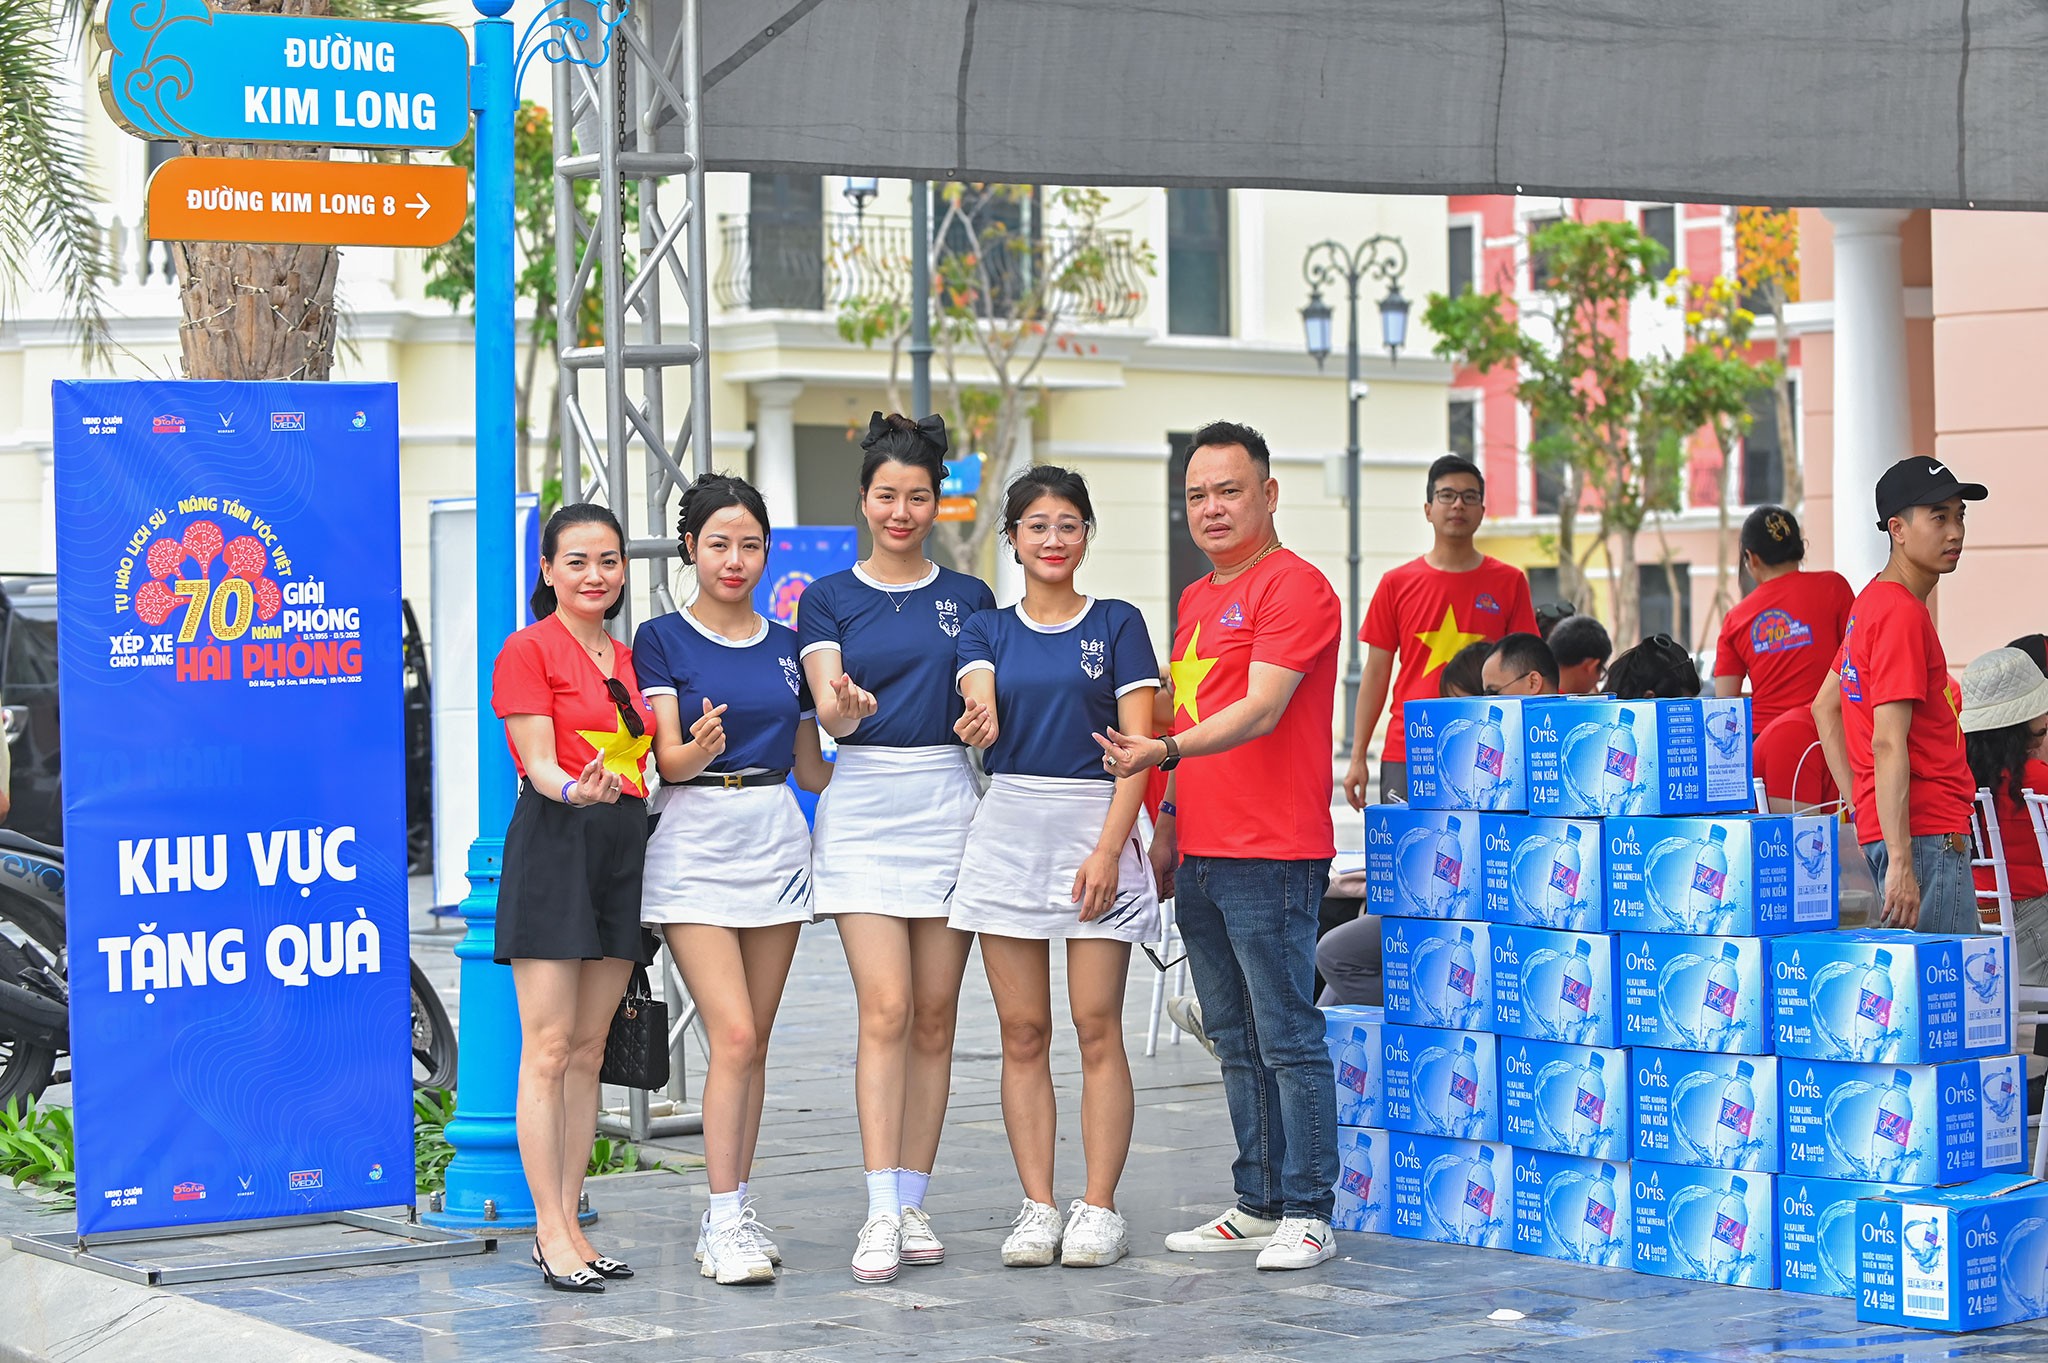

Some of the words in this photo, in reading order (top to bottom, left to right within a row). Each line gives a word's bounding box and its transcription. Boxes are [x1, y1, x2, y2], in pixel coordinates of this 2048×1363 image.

[284, 34, 395, 74] ĐƯỜNG
[244, 86, 320, 127] KIM
[335, 89, 436, 131] LONG
[187, 187, 264, 212] ĐƯỜNG
[272, 192, 314, 214] KIM
[320, 192, 376, 215] LONG
[383, 195, 396, 216] 8
[178, 495, 218, 515] NÂNG
[148, 507, 168, 530] SỬ
[126, 524, 153, 557] LỊCH
[251, 516, 279, 547] VÓC
[271, 545, 292, 577] VIỆT
[114, 557, 134, 590] HÀO
[283, 575, 325, 605] GIẢI
[114, 593, 132, 614] TỰ
[175, 578, 254, 643] 70
[252, 623, 282, 640] NĂM
[283, 605, 360, 633] PHÓNG
[109, 628, 144, 655] XẾP
[150, 634, 174, 653] XE
[109, 654, 139, 668] CHÀO
[141, 651, 174, 667] MỪNG
[176, 635, 231, 682] HẢI
[242, 635, 362, 679] PHÒNG
[1668, 766, 1680, 777] ION
[1413, 780, 1424, 797] 24
[1533, 786, 1546, 803] 24
[1669, 783, 1683, 800] 24
[118, 834, 228, 896] KHU
[247, 825, 357, 898] VỰC
[1372, 886, 1382, 902] 24
[1613, 882, 1628, 890] WATER
[1487, 893, 1497, 910] 24
[1613, 899, 1627, 917] 24
[1761, 904, 1773, 921] 24
[98, 922, 246, 1004] TẶNG
[265, 907, 381, 988] QUÀ
[1389, 993, 1399, 1010] 24
[1497, 1005, 1508, 1022] 24
[1627, 1014, 1640, 1032] 24
[1780, 1024, 1793, 1043] 24
[1929, 1030, 1942, 1049] 24
[1388, 1101, 1399, 1118] 24
[1508, 1115, 1519, 1132] 24
[1640, 1130, 1654, 1148] 24
[1791, 1142, 1805, 1160] 24
[1947, 1150, 1960, 1169] 24
[291, 1179, 321, 1187] MEDIA
[1397, 1208, 1408, 1225] 24
[1517, 1224, 1529, 1241] 24
[1637, 1242, 1650, 1260] 24
[1786, 1259, 1799, 1278] 24
[1862, 1271, 1875, 1284] ION
[1863, 1289, 1879, 1308] 24
[1879, 1291, 1895, 1303] chai
[1968, 1296, 1982, 1316] 24
